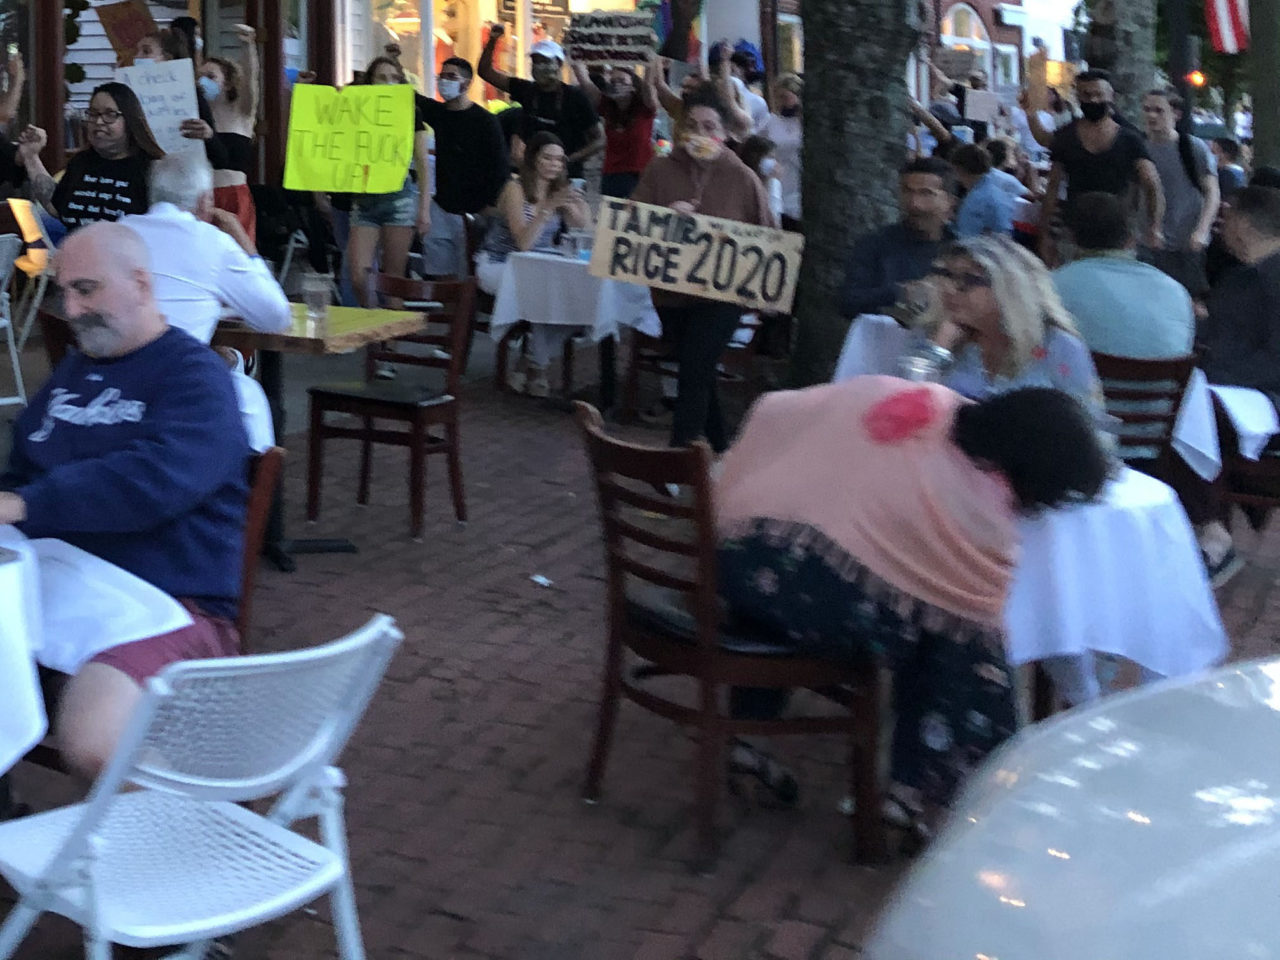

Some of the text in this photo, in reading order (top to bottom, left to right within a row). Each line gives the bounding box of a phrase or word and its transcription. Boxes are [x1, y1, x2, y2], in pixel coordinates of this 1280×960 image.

[314, 93, 393, 128] WAKE
[293, 129, 409, 167] THE FUCK
[610, 236, 680, 284] RICE
[687, 232, 788, 303] 2020
